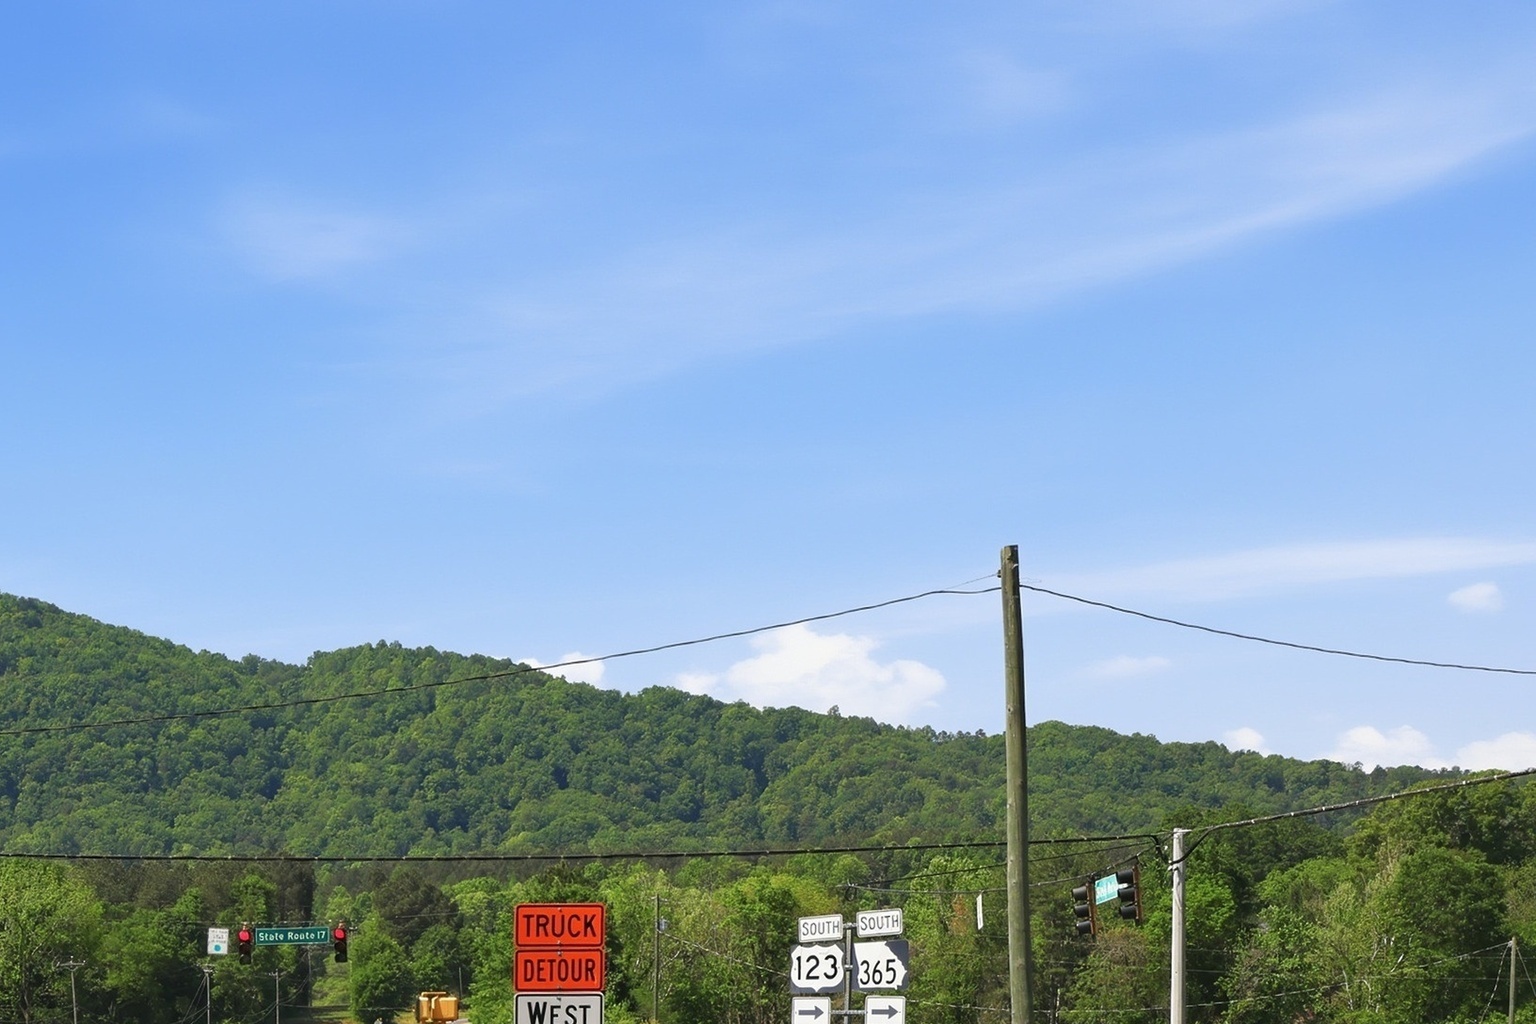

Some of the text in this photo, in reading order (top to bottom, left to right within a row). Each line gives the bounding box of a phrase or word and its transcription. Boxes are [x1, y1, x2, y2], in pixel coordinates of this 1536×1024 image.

[523, 914, 597, 938] TRUCK
[802, 920, 840, 936] SOUTH
[860, 914, 899, 931] SOUTH
[258, 930, 326, 941] State Route 17
[524, 958, 596, 983] DETOUR
[796, 954, 838, 980] 123
[859, 959, 896, 985] 365
